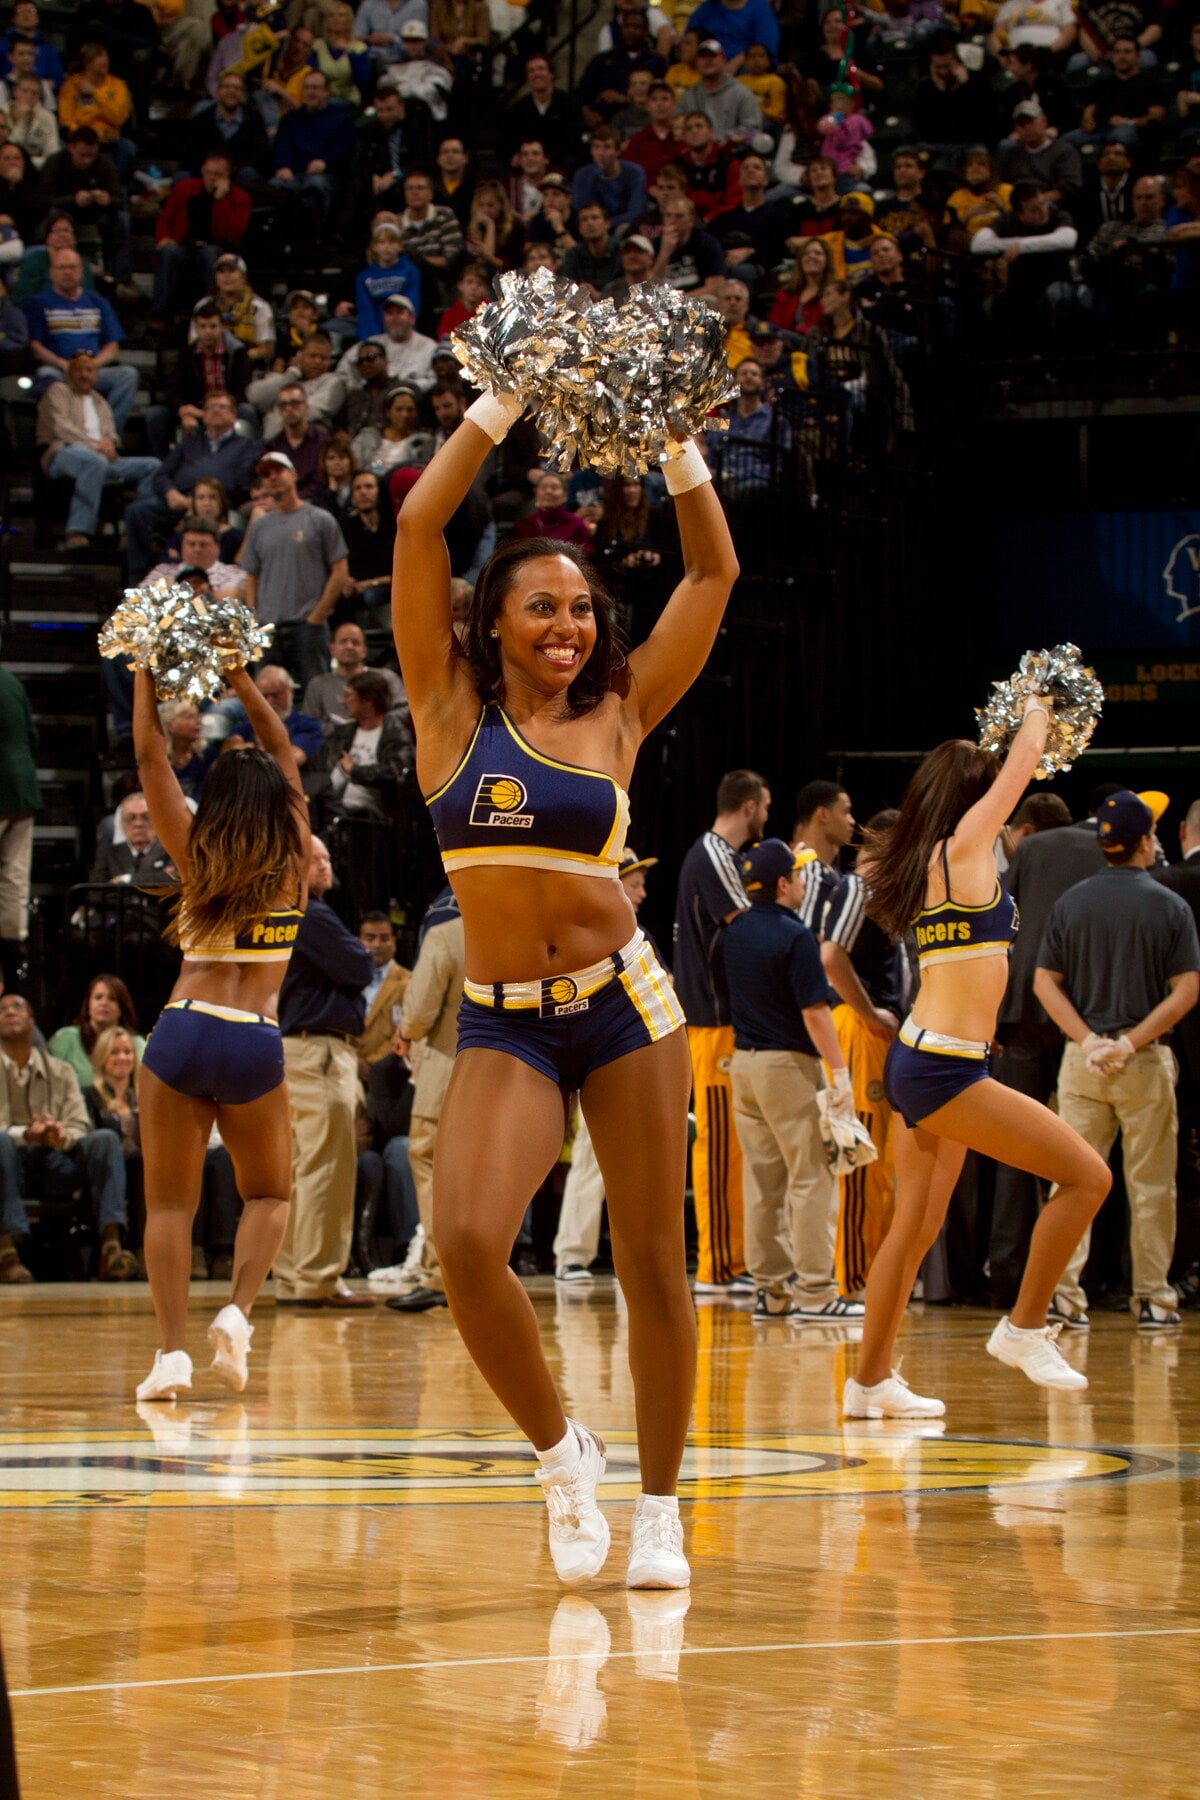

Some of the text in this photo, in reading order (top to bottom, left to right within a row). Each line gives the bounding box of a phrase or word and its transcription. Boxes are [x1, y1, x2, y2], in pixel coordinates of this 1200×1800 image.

[1106, 683, 1159, 703] OMS
[492, 814, 532, 826] Pacers
[557, 1001, 588, 1015] Pacers
